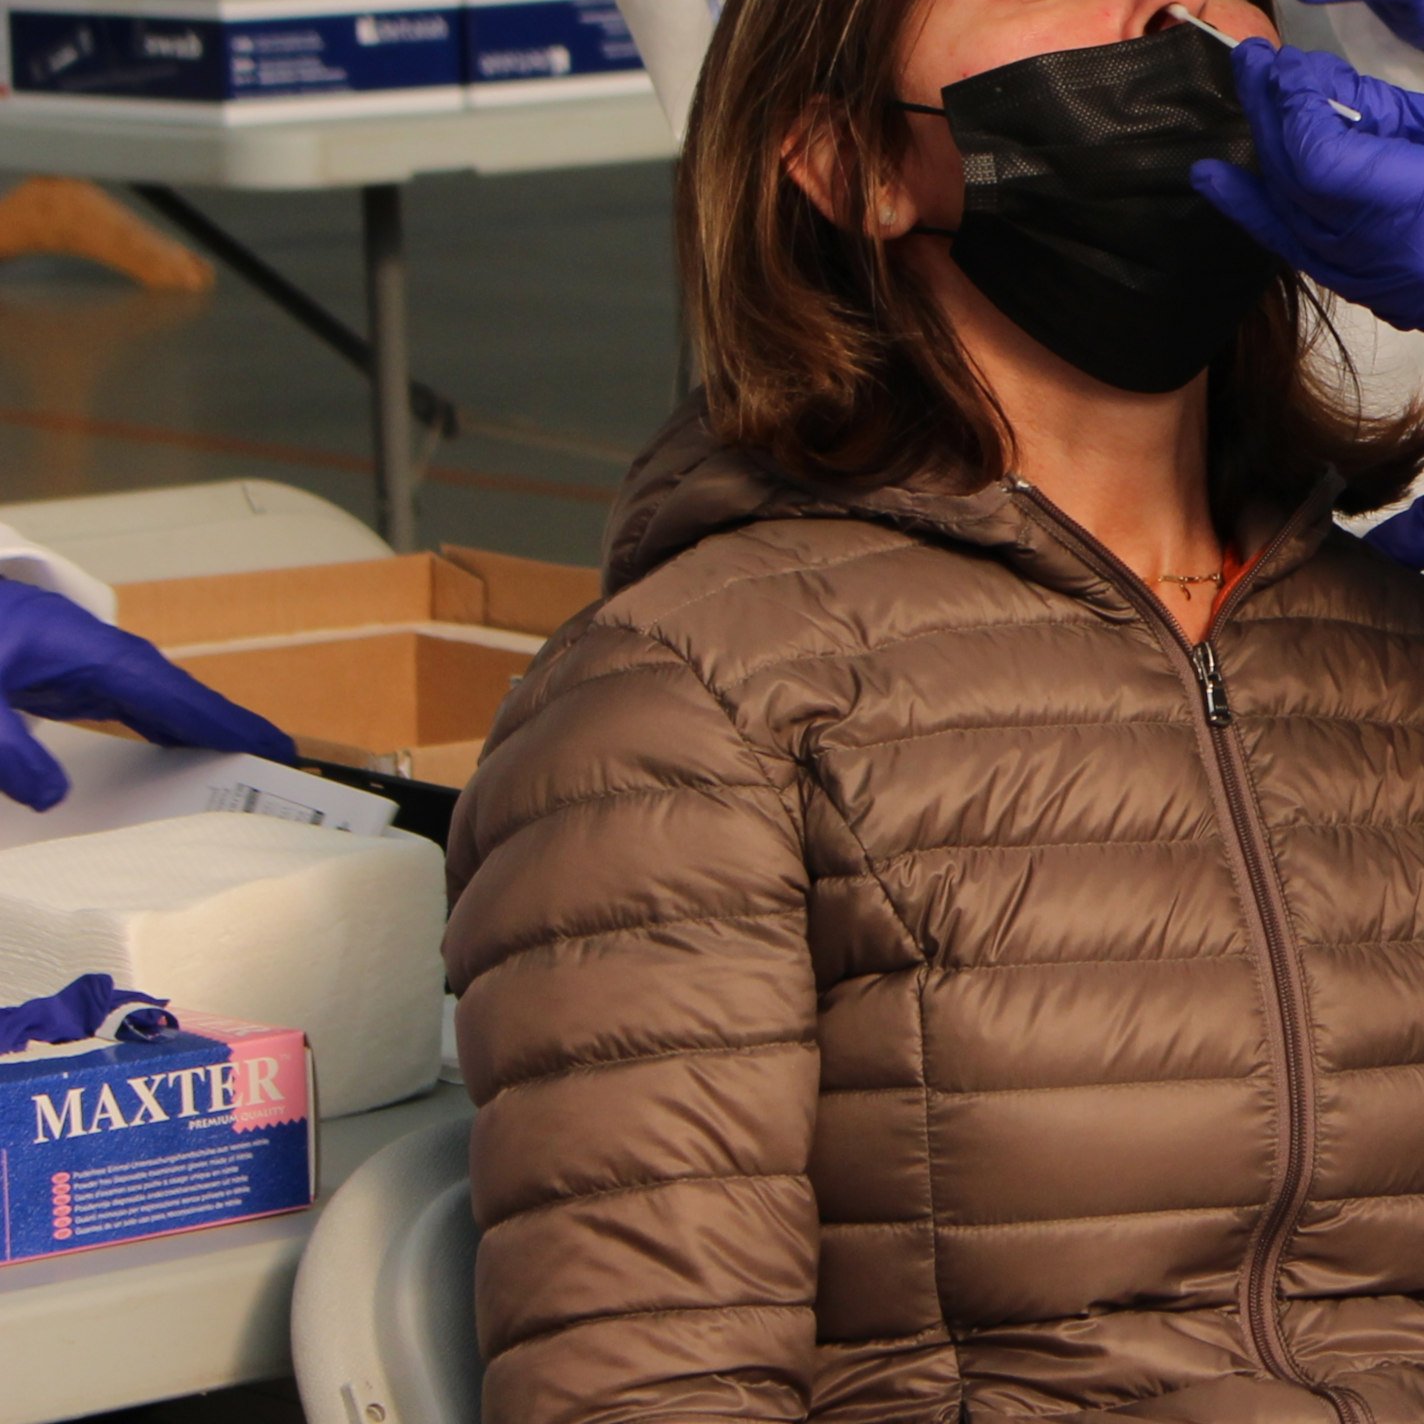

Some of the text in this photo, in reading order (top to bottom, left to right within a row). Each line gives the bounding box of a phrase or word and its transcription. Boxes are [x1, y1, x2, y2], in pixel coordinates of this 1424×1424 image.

[31, 1057, 286, 1145] MAXTER
[188, 1106, 287, 1130] PREMIUM QUALITY
